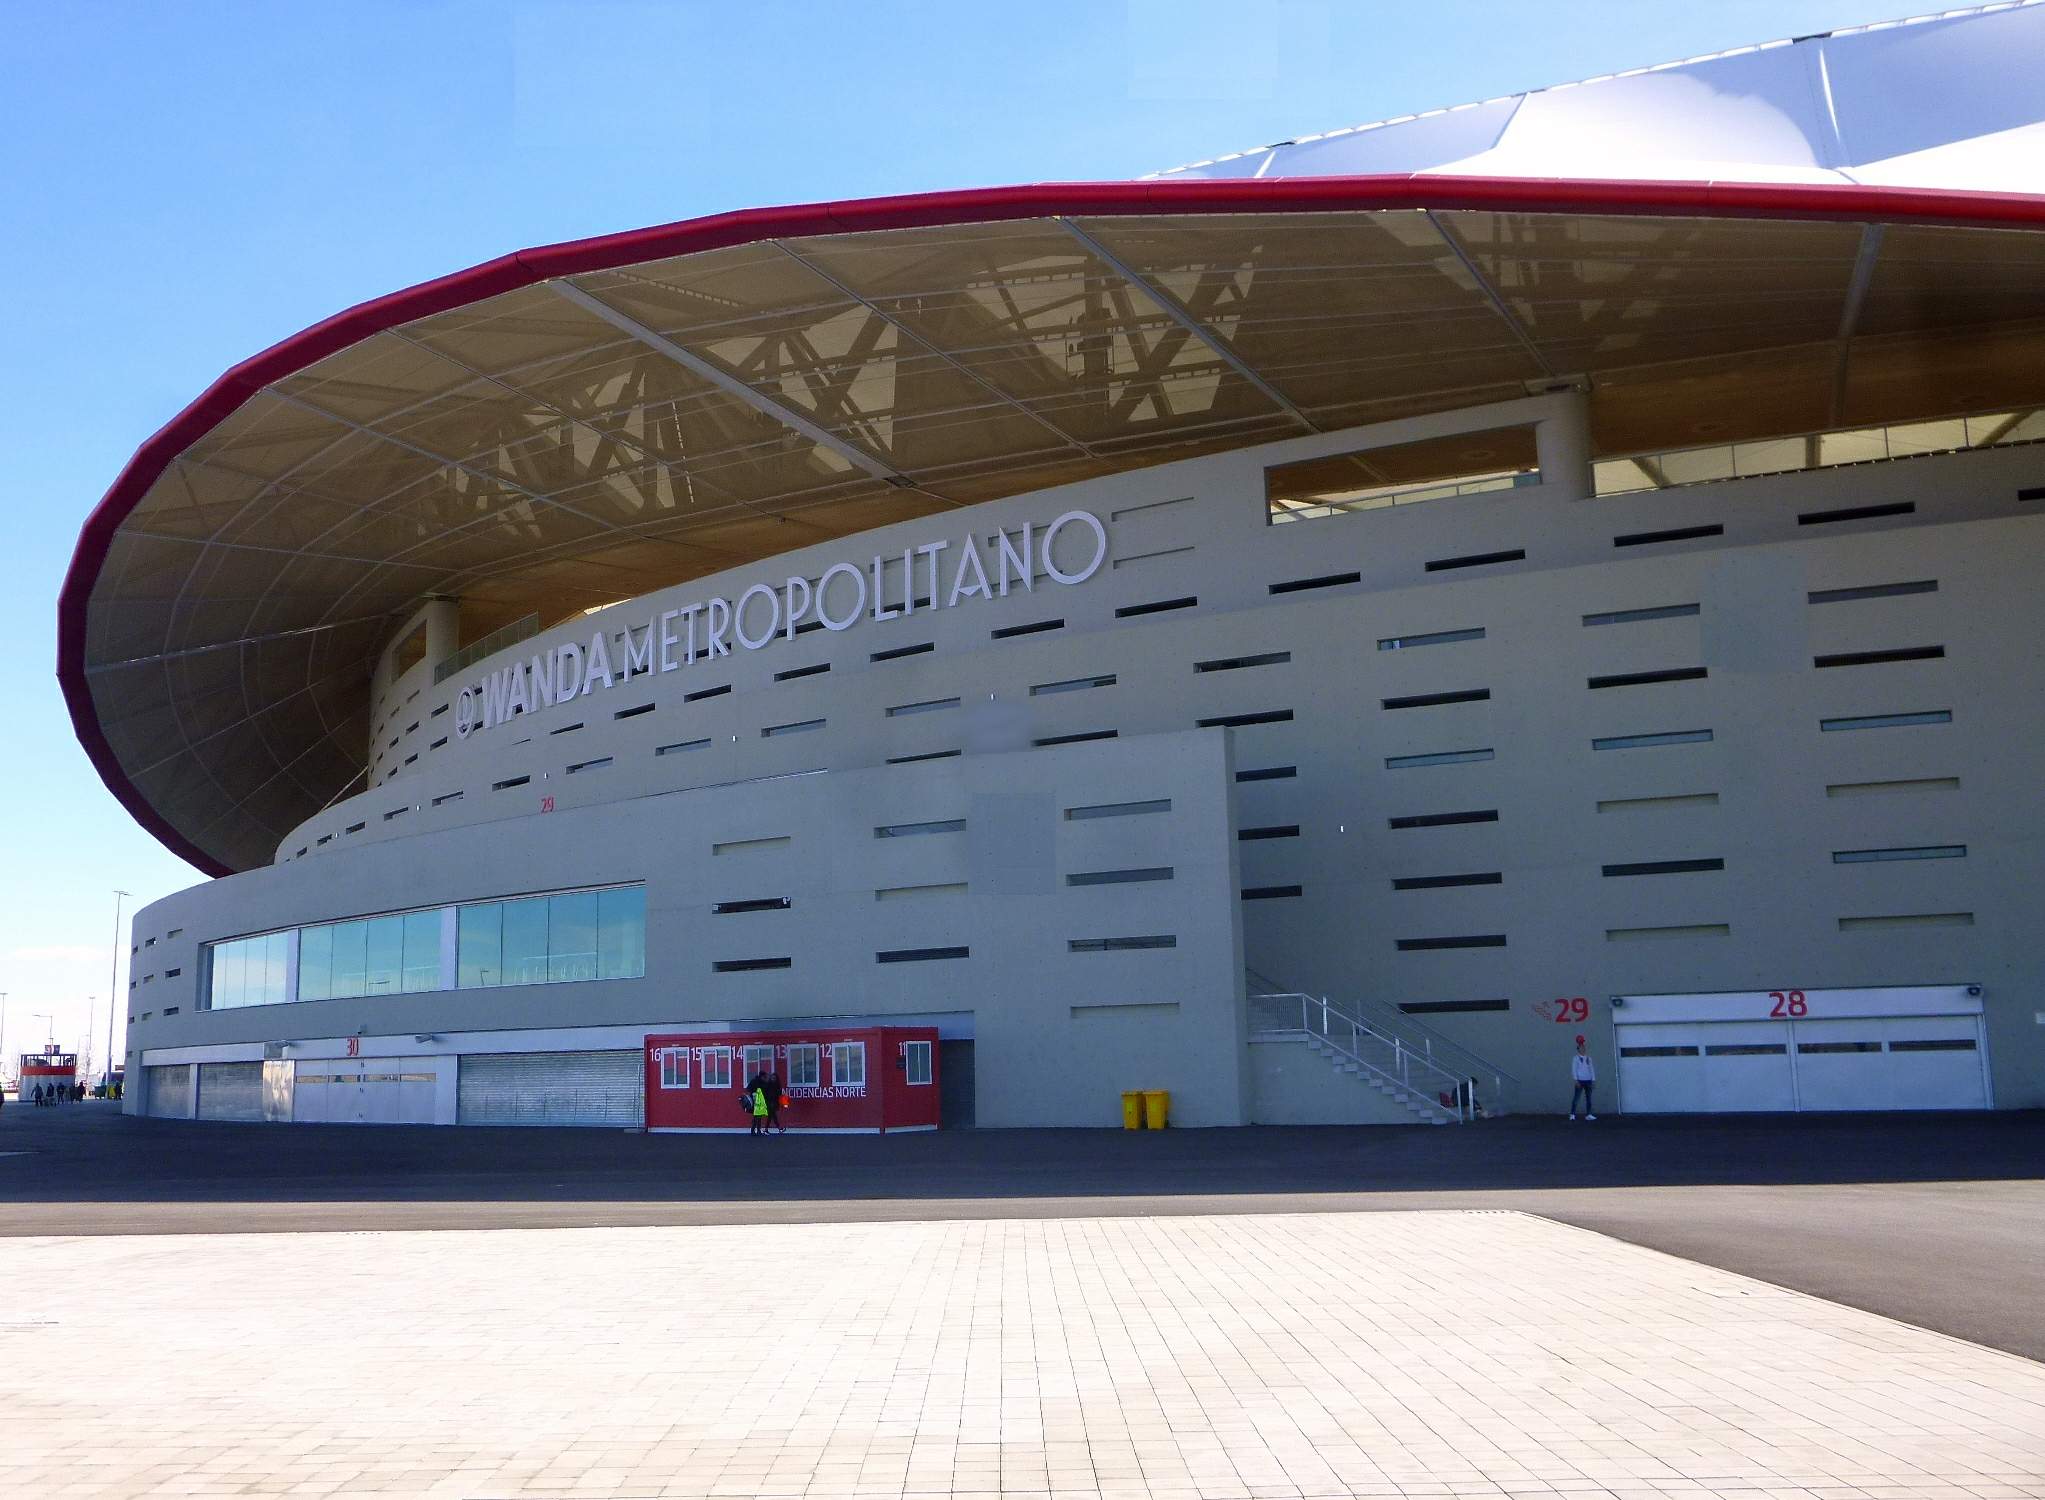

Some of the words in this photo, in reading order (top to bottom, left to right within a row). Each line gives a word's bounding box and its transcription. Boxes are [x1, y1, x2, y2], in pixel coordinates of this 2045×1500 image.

[482, 631, 615, 729] WANDA
[623, 509, 1107, 683] METROPOLITANO
[1555, 998, 1588, 1023] 29
[1769, 990, 1808, 1017] 28
[347, 1037, 359, 1056] 30
[690, 1047, 702, 1060] 15
[731, 1045, 744, 1060] 14
[776, 1044, 788, 1059] 13
[820, 1043, 833, 1058] 12
[649, 1048, 661, 1062] 16
[781, 1086, 834, 1099] NCIDENCIAS
[835, 1086, 867, 1098] NORTE
